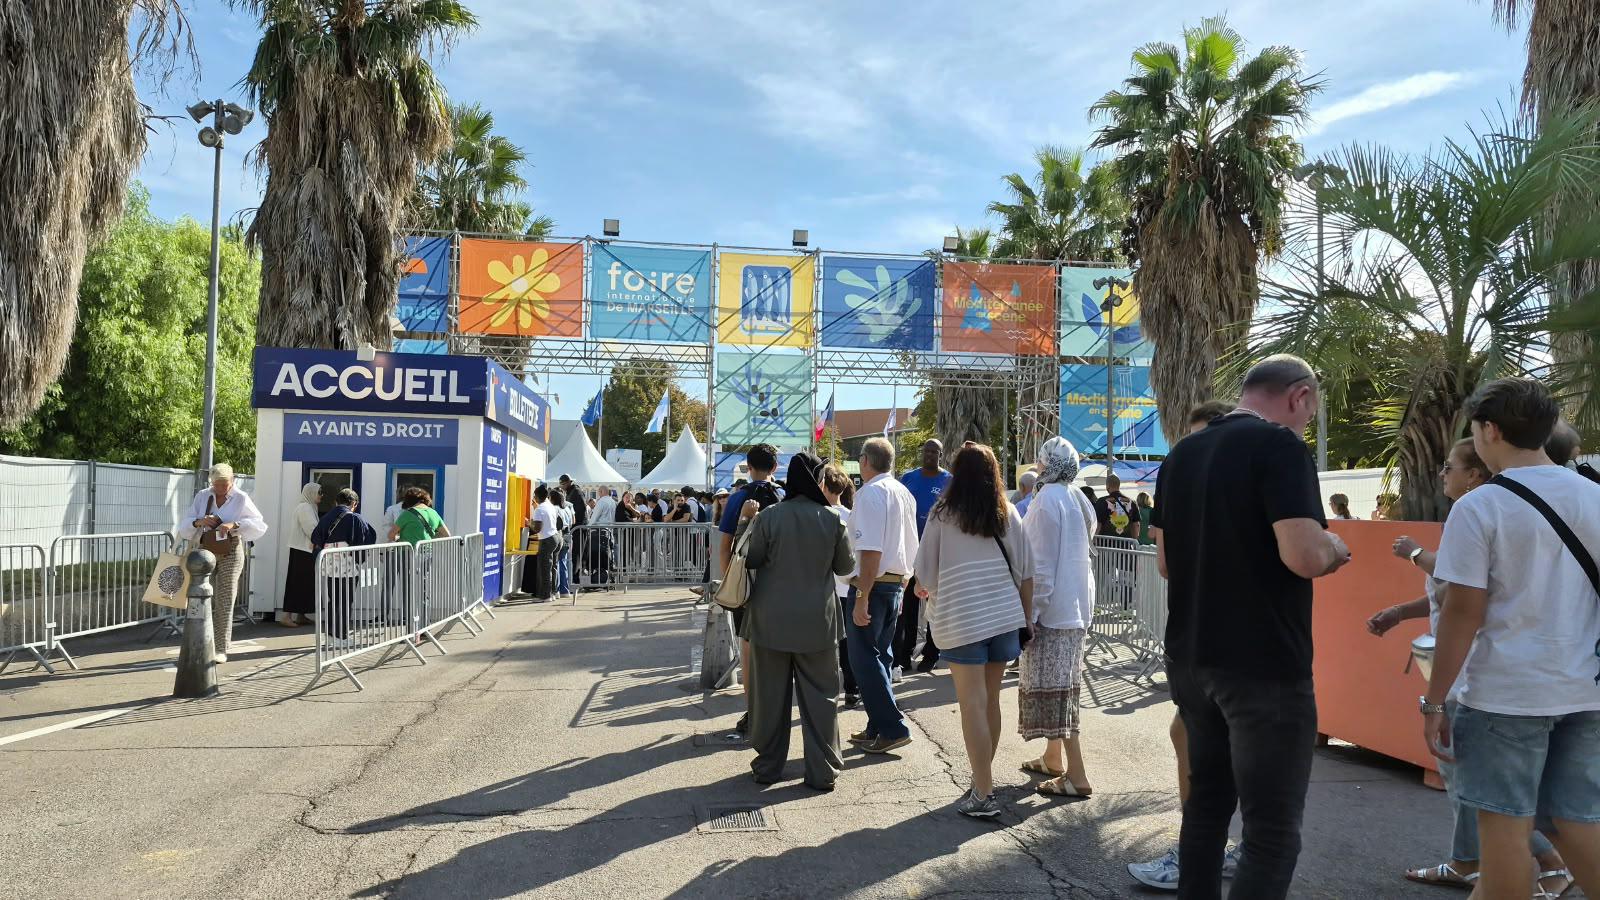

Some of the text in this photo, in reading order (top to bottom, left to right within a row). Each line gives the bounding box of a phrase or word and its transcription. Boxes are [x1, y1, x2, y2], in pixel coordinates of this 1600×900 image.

[607, 261, 695, 295] foire
[270, 362, 470, 403] ACCUEIL
[298, 420, 445, 439] AYANTS DROIT
